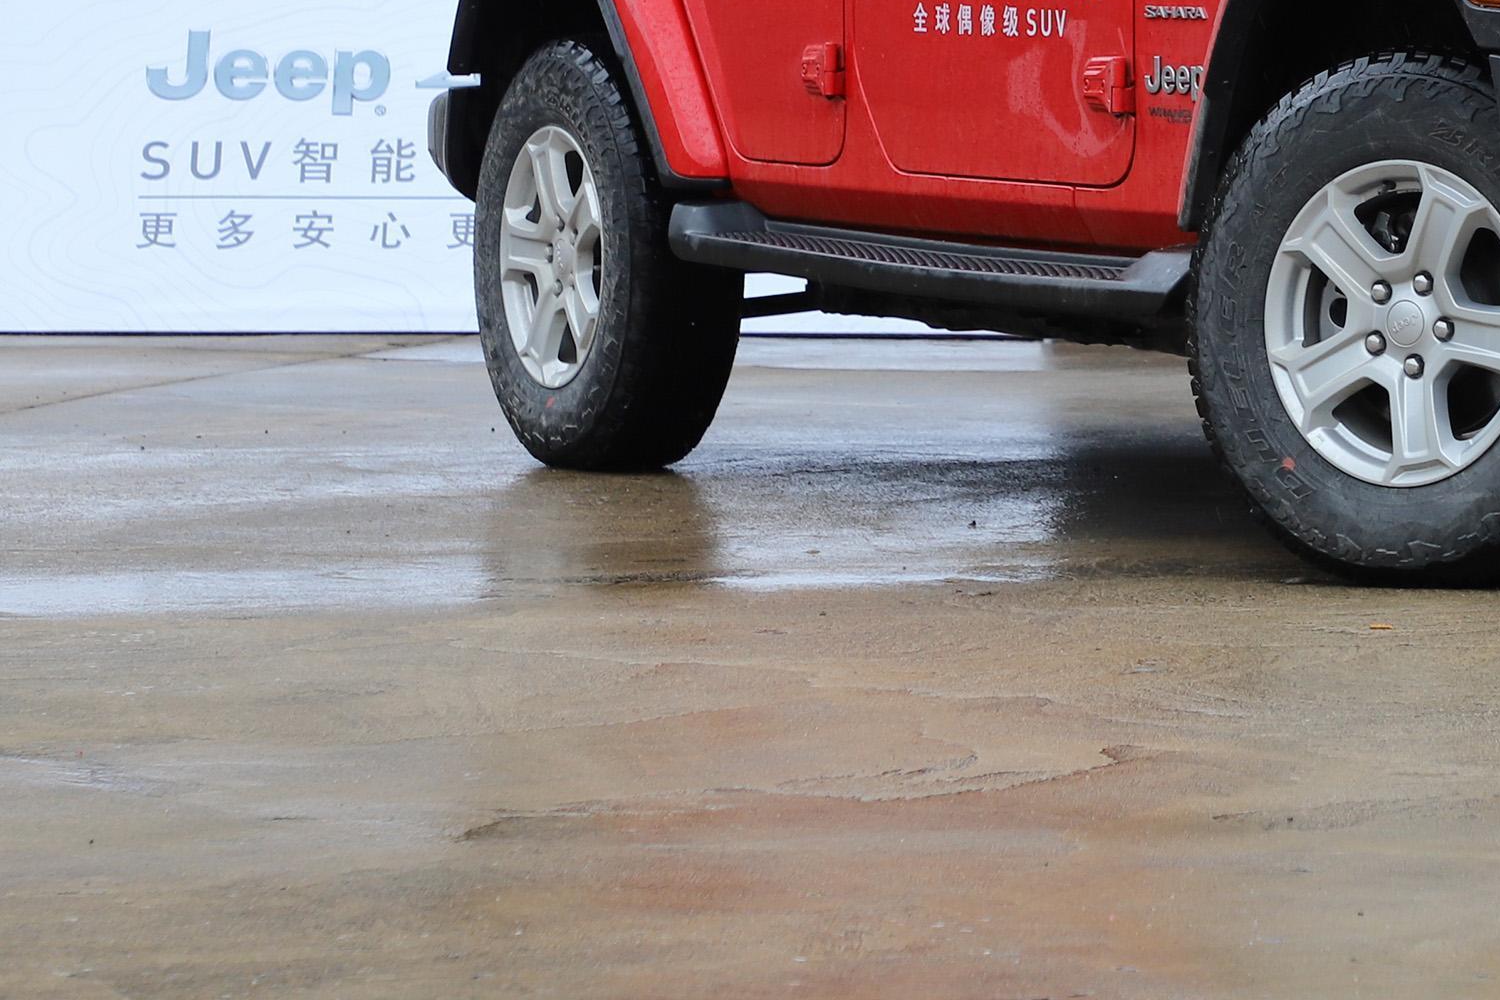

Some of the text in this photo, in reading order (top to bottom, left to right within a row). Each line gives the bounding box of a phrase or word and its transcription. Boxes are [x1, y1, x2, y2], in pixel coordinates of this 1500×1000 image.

[913, 2, 1066, 37] 全球偶像级SUV
[1144, 5, 1208, 19] SAHARA
[145, 29, 391, 116] Jeep
[1144, 56, 1203, 102] Jeep
[140, 137, 417, 184] SUV智能
